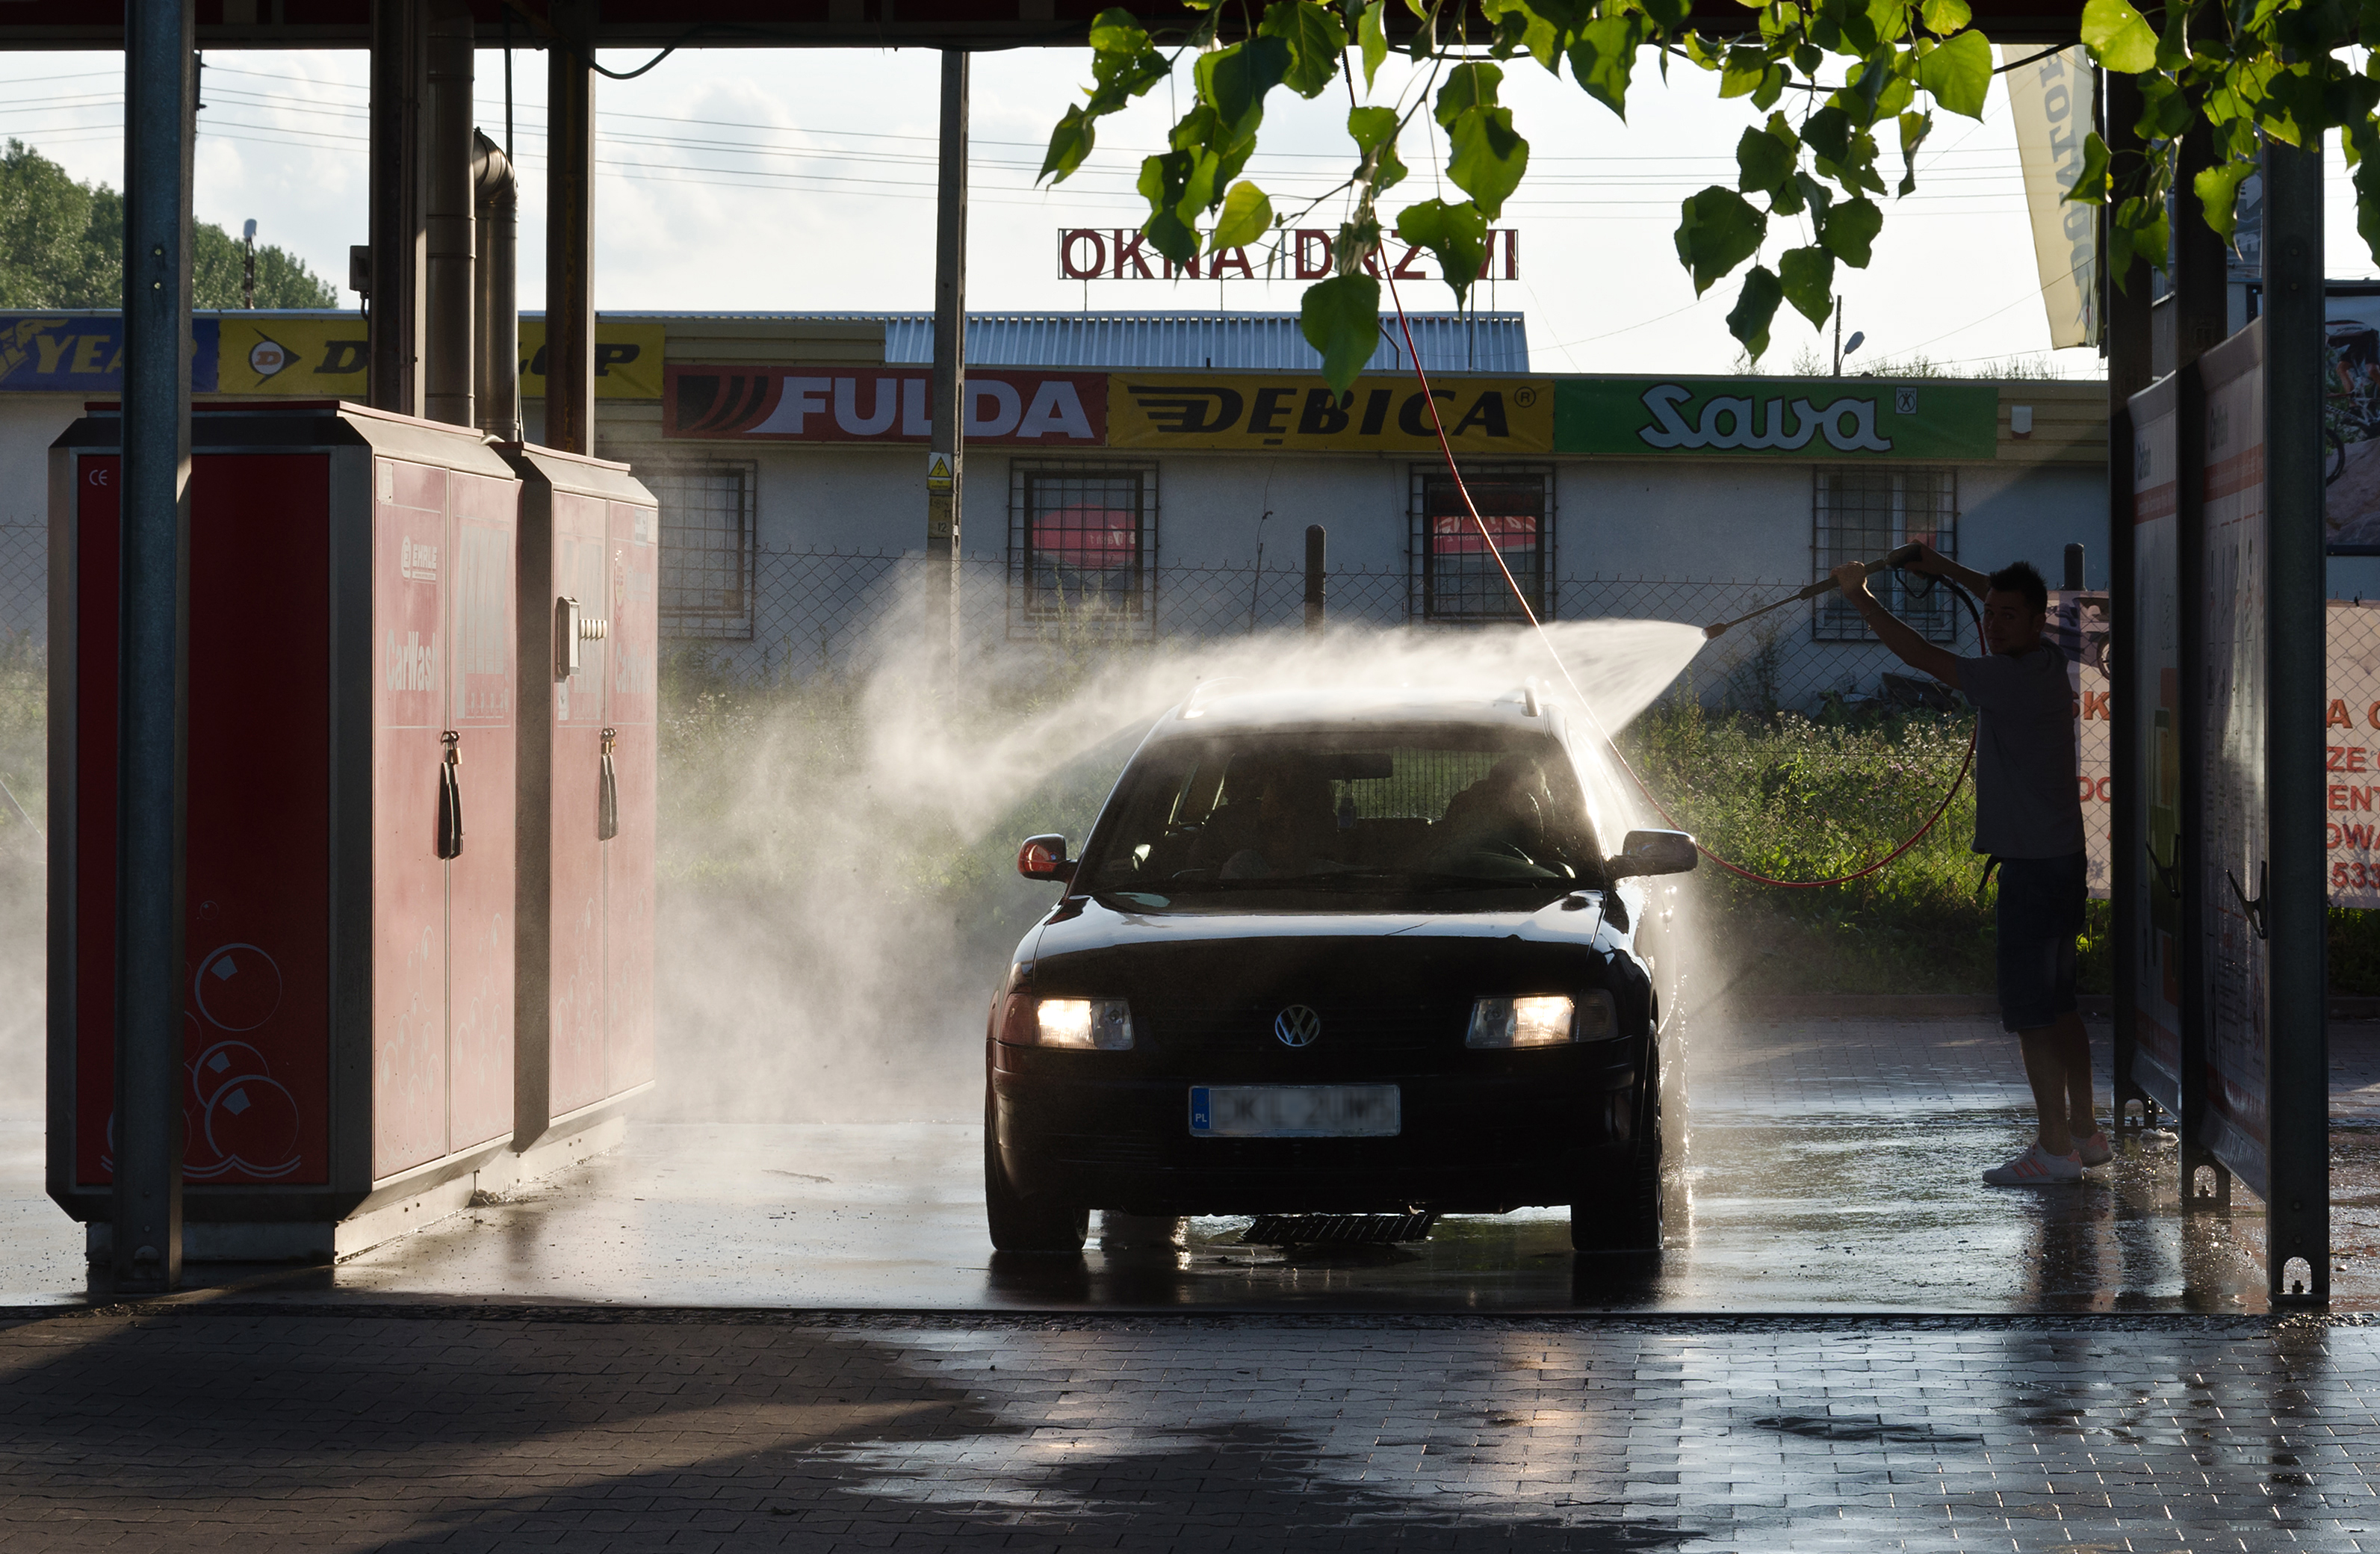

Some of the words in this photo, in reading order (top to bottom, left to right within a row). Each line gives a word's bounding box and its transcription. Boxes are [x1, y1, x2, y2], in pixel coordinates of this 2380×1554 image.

[743, 376, 1095, 439] FULDA
[412, 543, 438, 569] EHRLE
[385, 628, 438, 693] CarWash
[1195, 1113, 1207, 1123] PL
